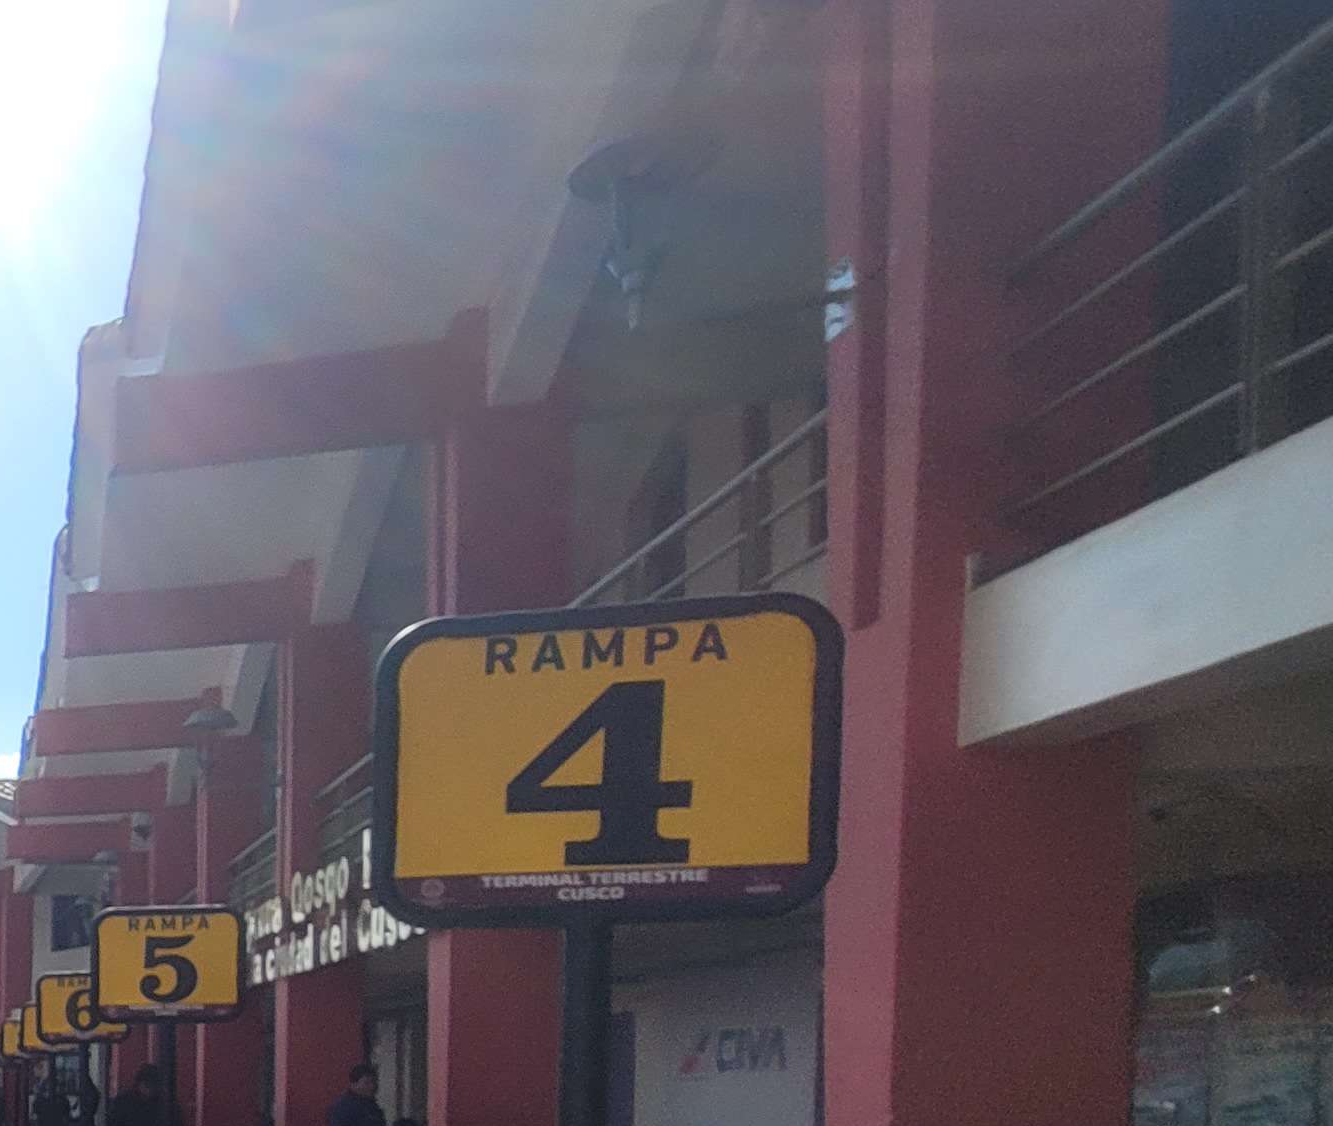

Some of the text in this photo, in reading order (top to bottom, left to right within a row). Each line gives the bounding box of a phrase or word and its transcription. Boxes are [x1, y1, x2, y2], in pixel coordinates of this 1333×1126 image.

[484, 622, 728, 675] RAMPA
[506, 679, 693, 867] 4
[482, 869, 709, 888] TERMINAL TERRESTRE
[556, 886, 625, 901] CUSCO
[128, 915, 210, 932] RAMPA
[357, 898, 427, 953] Cus
[139, 934, 198, 1003] 5
[66, 988, 101, 1032] 6
